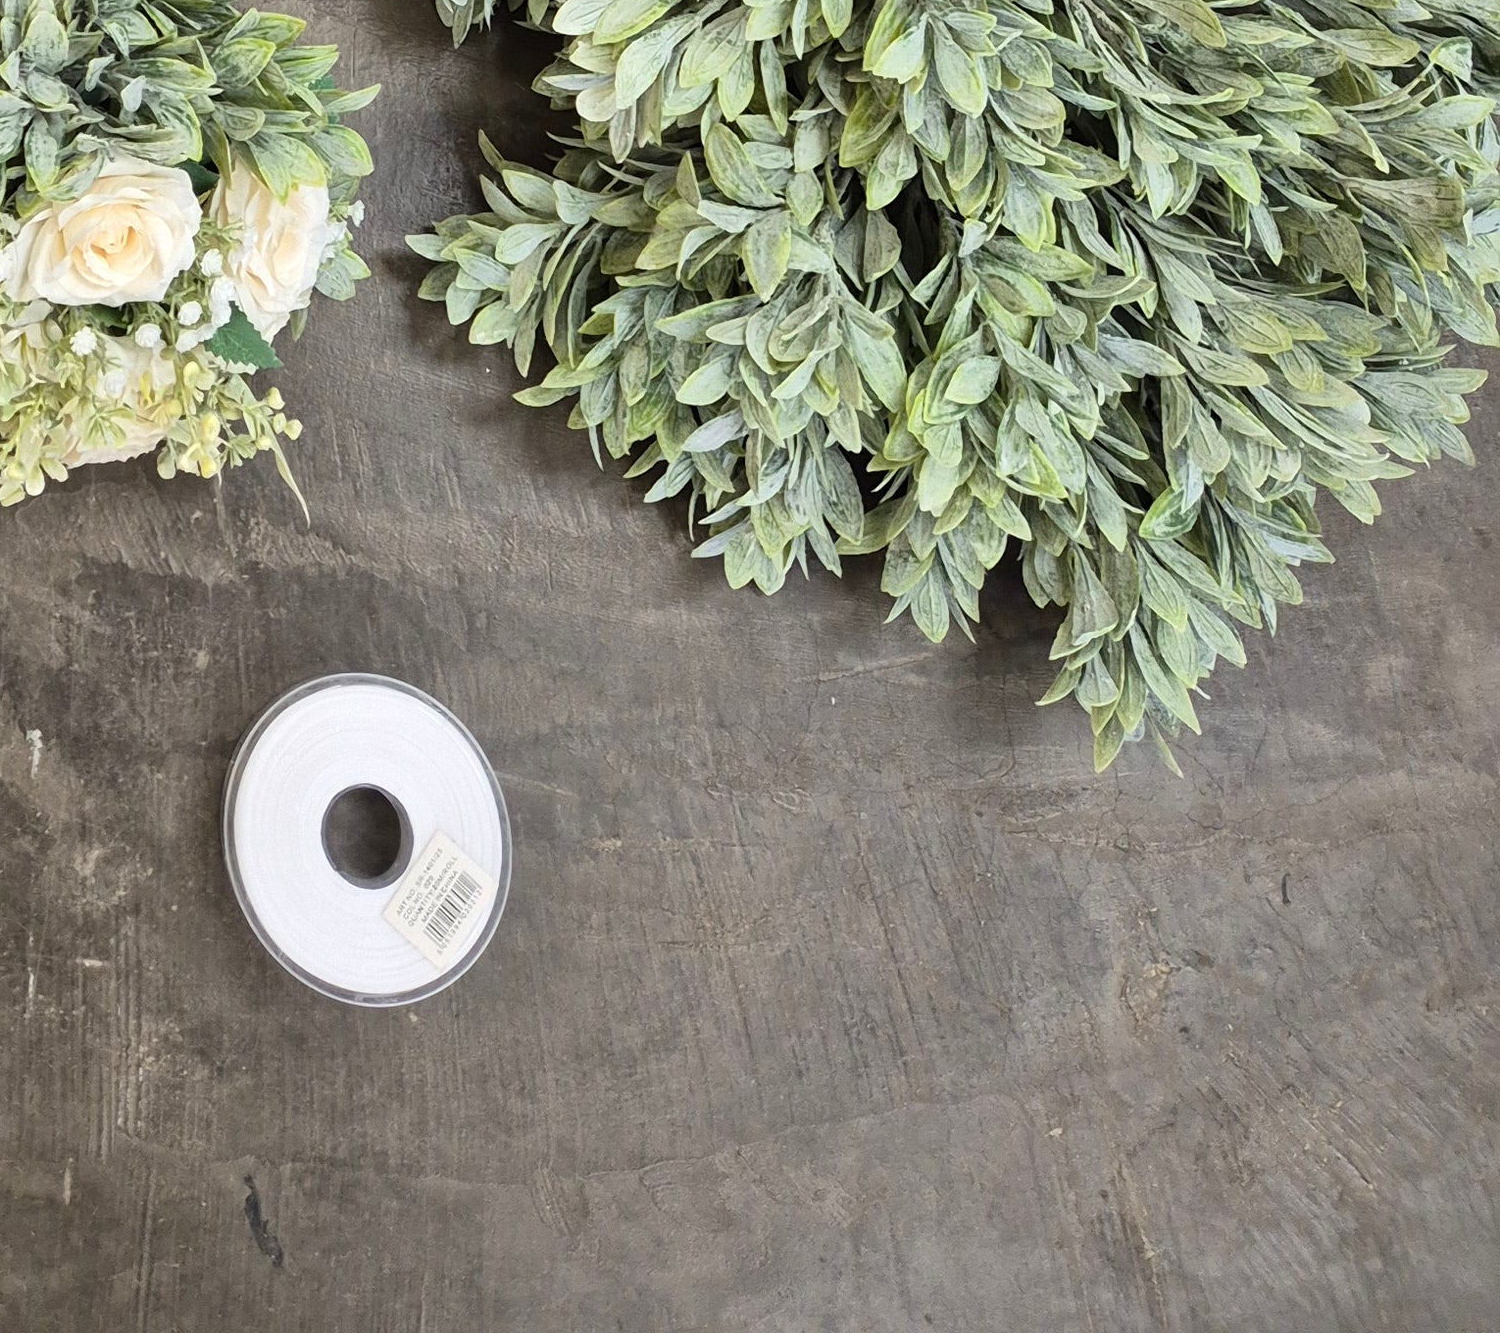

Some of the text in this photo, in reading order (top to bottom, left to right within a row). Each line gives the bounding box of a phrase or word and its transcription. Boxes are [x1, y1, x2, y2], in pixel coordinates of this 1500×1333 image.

[421, 869, 458, 923] MADE IN CHINA
